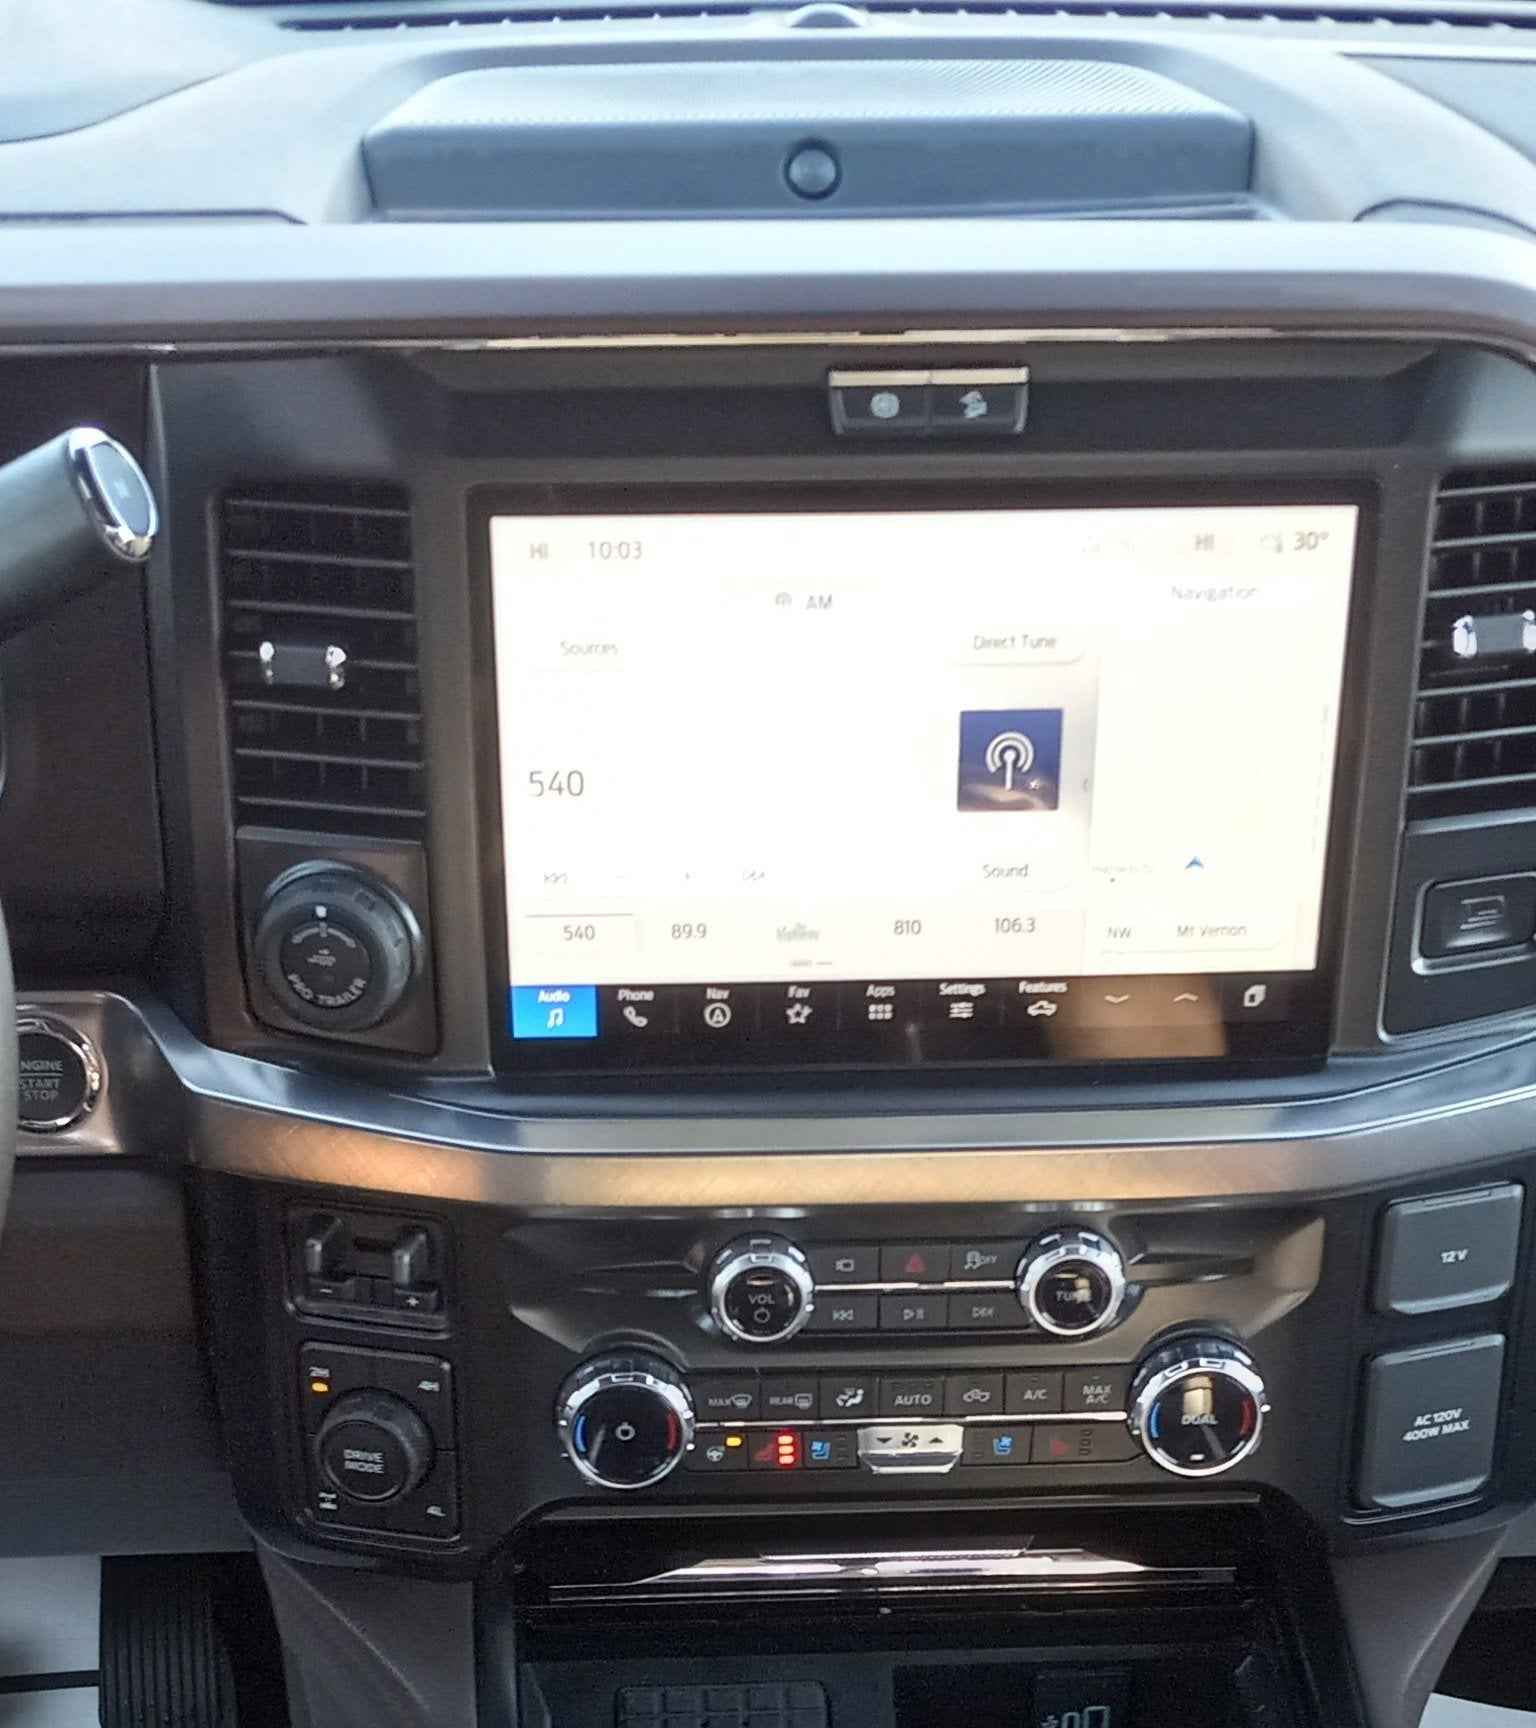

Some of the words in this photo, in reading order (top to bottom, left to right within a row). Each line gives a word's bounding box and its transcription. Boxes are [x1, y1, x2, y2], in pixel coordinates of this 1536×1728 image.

[1195, 534, 1214, 550] HI
[1294, 531, 1330, 551] 30°
[529, 543, 549, 560] HI
[587, 541, 643, 561] 10:03
[806, 595, 834, 610] AM
[559, 640, 618, 656] Sources
[973, 634, 1015, 650] Direct
[1021, 634, 1058, 650] Tune
[527, 769, 585, 797] 540
[982, 864, 1029, 879] Sound
[563, 924, 596, 941] 540
[670, 924, 708, 940] 89.9
[893, 919, 922, 936] 810
[994, 917, 1037, 934] 106.3
[706, 987, 730, 1002] Nav
[787, 985, 811, 1001] Fav
[866, 983, 895, 1002] Apps
[939, 981, 986, 999] Settings
[1018, 979, 1067, 996] Features
[538, 990, 570, 1004] Audio
[618, 989, 654, 1003] Phone
[20, 1060, 64, 1072] NGINE
[24, 1091, 59, 1102] STOP
[748, 1294, 776, 1306] VOL
[1023, 1388, 1048, 1401] A/C
[1082, 1384, 1112, 1396] MAX
[894, 1394, 932, 1407] AUTO
[1085, 1393, 1109, 1405] A/C
[1181, 1413, 1219, 1426] DUAL
[1413, 1414, 1431, 1427] AC
[1432, 1408, 1463, 1425] 120V
[1402, 1425, 1441, 1442] 400W
[1441, 1419, 1470, 1435] MAX
[342, 1448, 384, 1463] DRIVE
[343, 1460, 384, 1474] MODE
